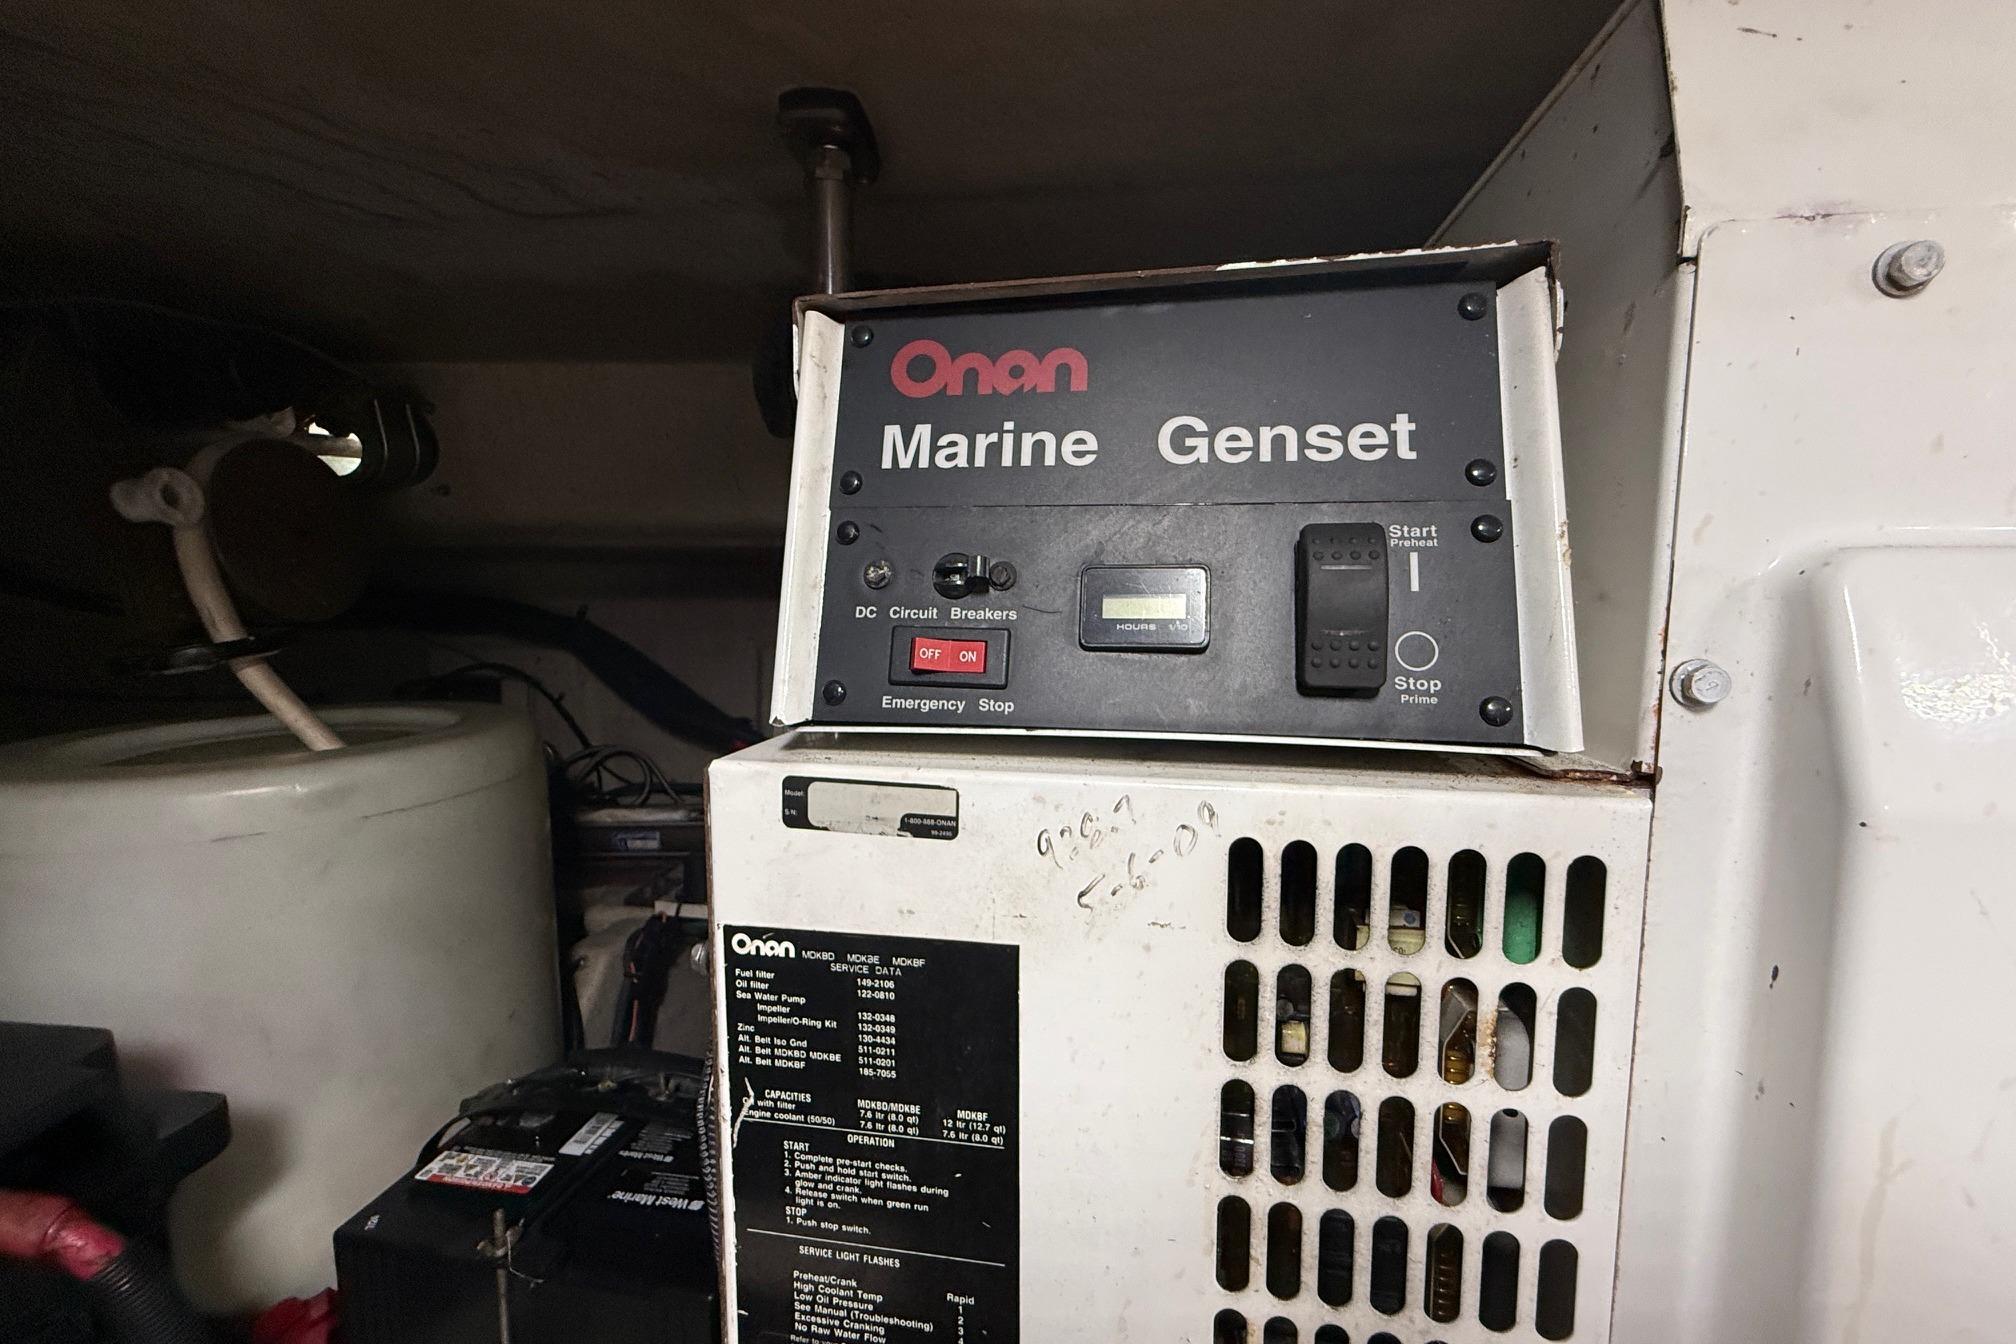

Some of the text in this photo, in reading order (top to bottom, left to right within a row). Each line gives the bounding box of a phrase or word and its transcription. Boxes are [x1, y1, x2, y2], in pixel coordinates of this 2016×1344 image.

[890, 339, 1088, 398] Onan
[881, 413, 1417, 470] Marine Genset
[1389, 524, 1437, 538] Start
[1391, 538, 1438, 547] Preheat
[856, 606, 1018, 620] DC Circuit Breakers
[920, 648, 976, 662] OFF ON
[1395, 676, 1442, 693] Stop
[882, 696, 1014, 714] Emergency Stop
[1400, 694, 1438, 704] Prime
[731, 933, 795, 958] Onan
[802, 951, 926, 967] MDKBD MDKBE MDKBF
[736, 969, 774, 979] Fuel filter
[831, 963, 902, 976] SERVICE DATA
[750, 981, 769, 989] filter
[736, 991, 806, 1005] Sea Water Pump
[757, 1004, 790, 1013] Impeller
[737, 1023, 755, 1031] Zinc
[758, 1015, 837, 1029] Impeller/O-Ring Kit
[738, 1034, 807, 1047] Alt. Belt Iso Gnd
[739, 1045, 841, 1062] Alt. Belt MDKBD MDKBE
[739, 1056, 806, 1069] Alt. Belt MDKBF
[765, 1089, 811, 1102] CAPACITIES
[777, 1101, 795, 1110] filter
[858, 1099, 920, 1114] MDKBD/MDKBE
[774, 1113, 804, 1121] coolant
[807, 1116, 835, 1126] (50/50)
[860, 1110, 872, 1118] 7.6
[888, 1112, 903, 1122] (8.0
[907, 1116, 919, 1125] qt)
[957, 1109, 988, 1121] MDKBF
[860, 1121, 872, 1129] 7.6
[888, 1123, 903, 1133] (8.0
[907, 1127, 919, 1136] qt)
[943, 1119, 953, 1127] 12
[969, 1122, 990, 1131] (12.7
[994, 1126, 1006, 1134] qt)
[847, 1134, 895, 1147] OPERATION
[943, 1130, 955, 1138] 7.6
[972, 1132, 988, 1142] (8.0
[991, 1136, 1003, 1145] qt)
[784, 1141, 809, 1151] START
[794, 1153, 833, 1164] Complete
[837, 1158, 871, 1168] pre-start
[875, 1162, 907, 1172] checks.
[794, 1161, 815, 1170] Push
[819, 1164, 834, 1173] and
[838, 1166, 855, 1175] hold
[859, 1169, 878, 1178] start
[882, 1172, 911, 1182] switch.
[795, 1170, 822, 1180] Amber
[825, 1173, 861, 1185] indicator
[865, 1179, 883, 1188] light
[887, 1181, 917, 1192] flashes
[921, 1185, 949, 1197] during
[795, 1180, 862, 1194] glow and crank.
[612, 1190, 688, 1209] West Marine
[796, 1188, 828, 1198] Release
[831, 1192, 857, 1202] switch
[861, 1196, 883, 1206] when
[887, 1199, 910, 1209] green
[914, 1203, 928, 1211] run
[796, 1197, 840, 1209] light is on.
[786, 1206, 807, 1216] STOP
[797, 1218, 817, 1227] Push
[820, 1221, 838, 1231] stop
[842, 1224, 871, 1234] switch.
[799, 1245, 900, 1268] SERVICE LIGHT FLASHES
[794, 1271, 857, 1287] Preheat/Crank
[794, 1281, 883, 1303] High Coolant Temp
[947, 1293, 974, 1305] Rapid
[794, 1292, 874, 1310] Low Oil Pressure
[795, 1302, 933, 1332] See Manual (Troubleshooting)
[795, 1312, 885, 1335] Excessive Cranking
[795, 1322, 886, 1344] No Raw Water Flow
[958, 1327, 964, 1335] 3
[790, 1334, 809, 1344] Refer
